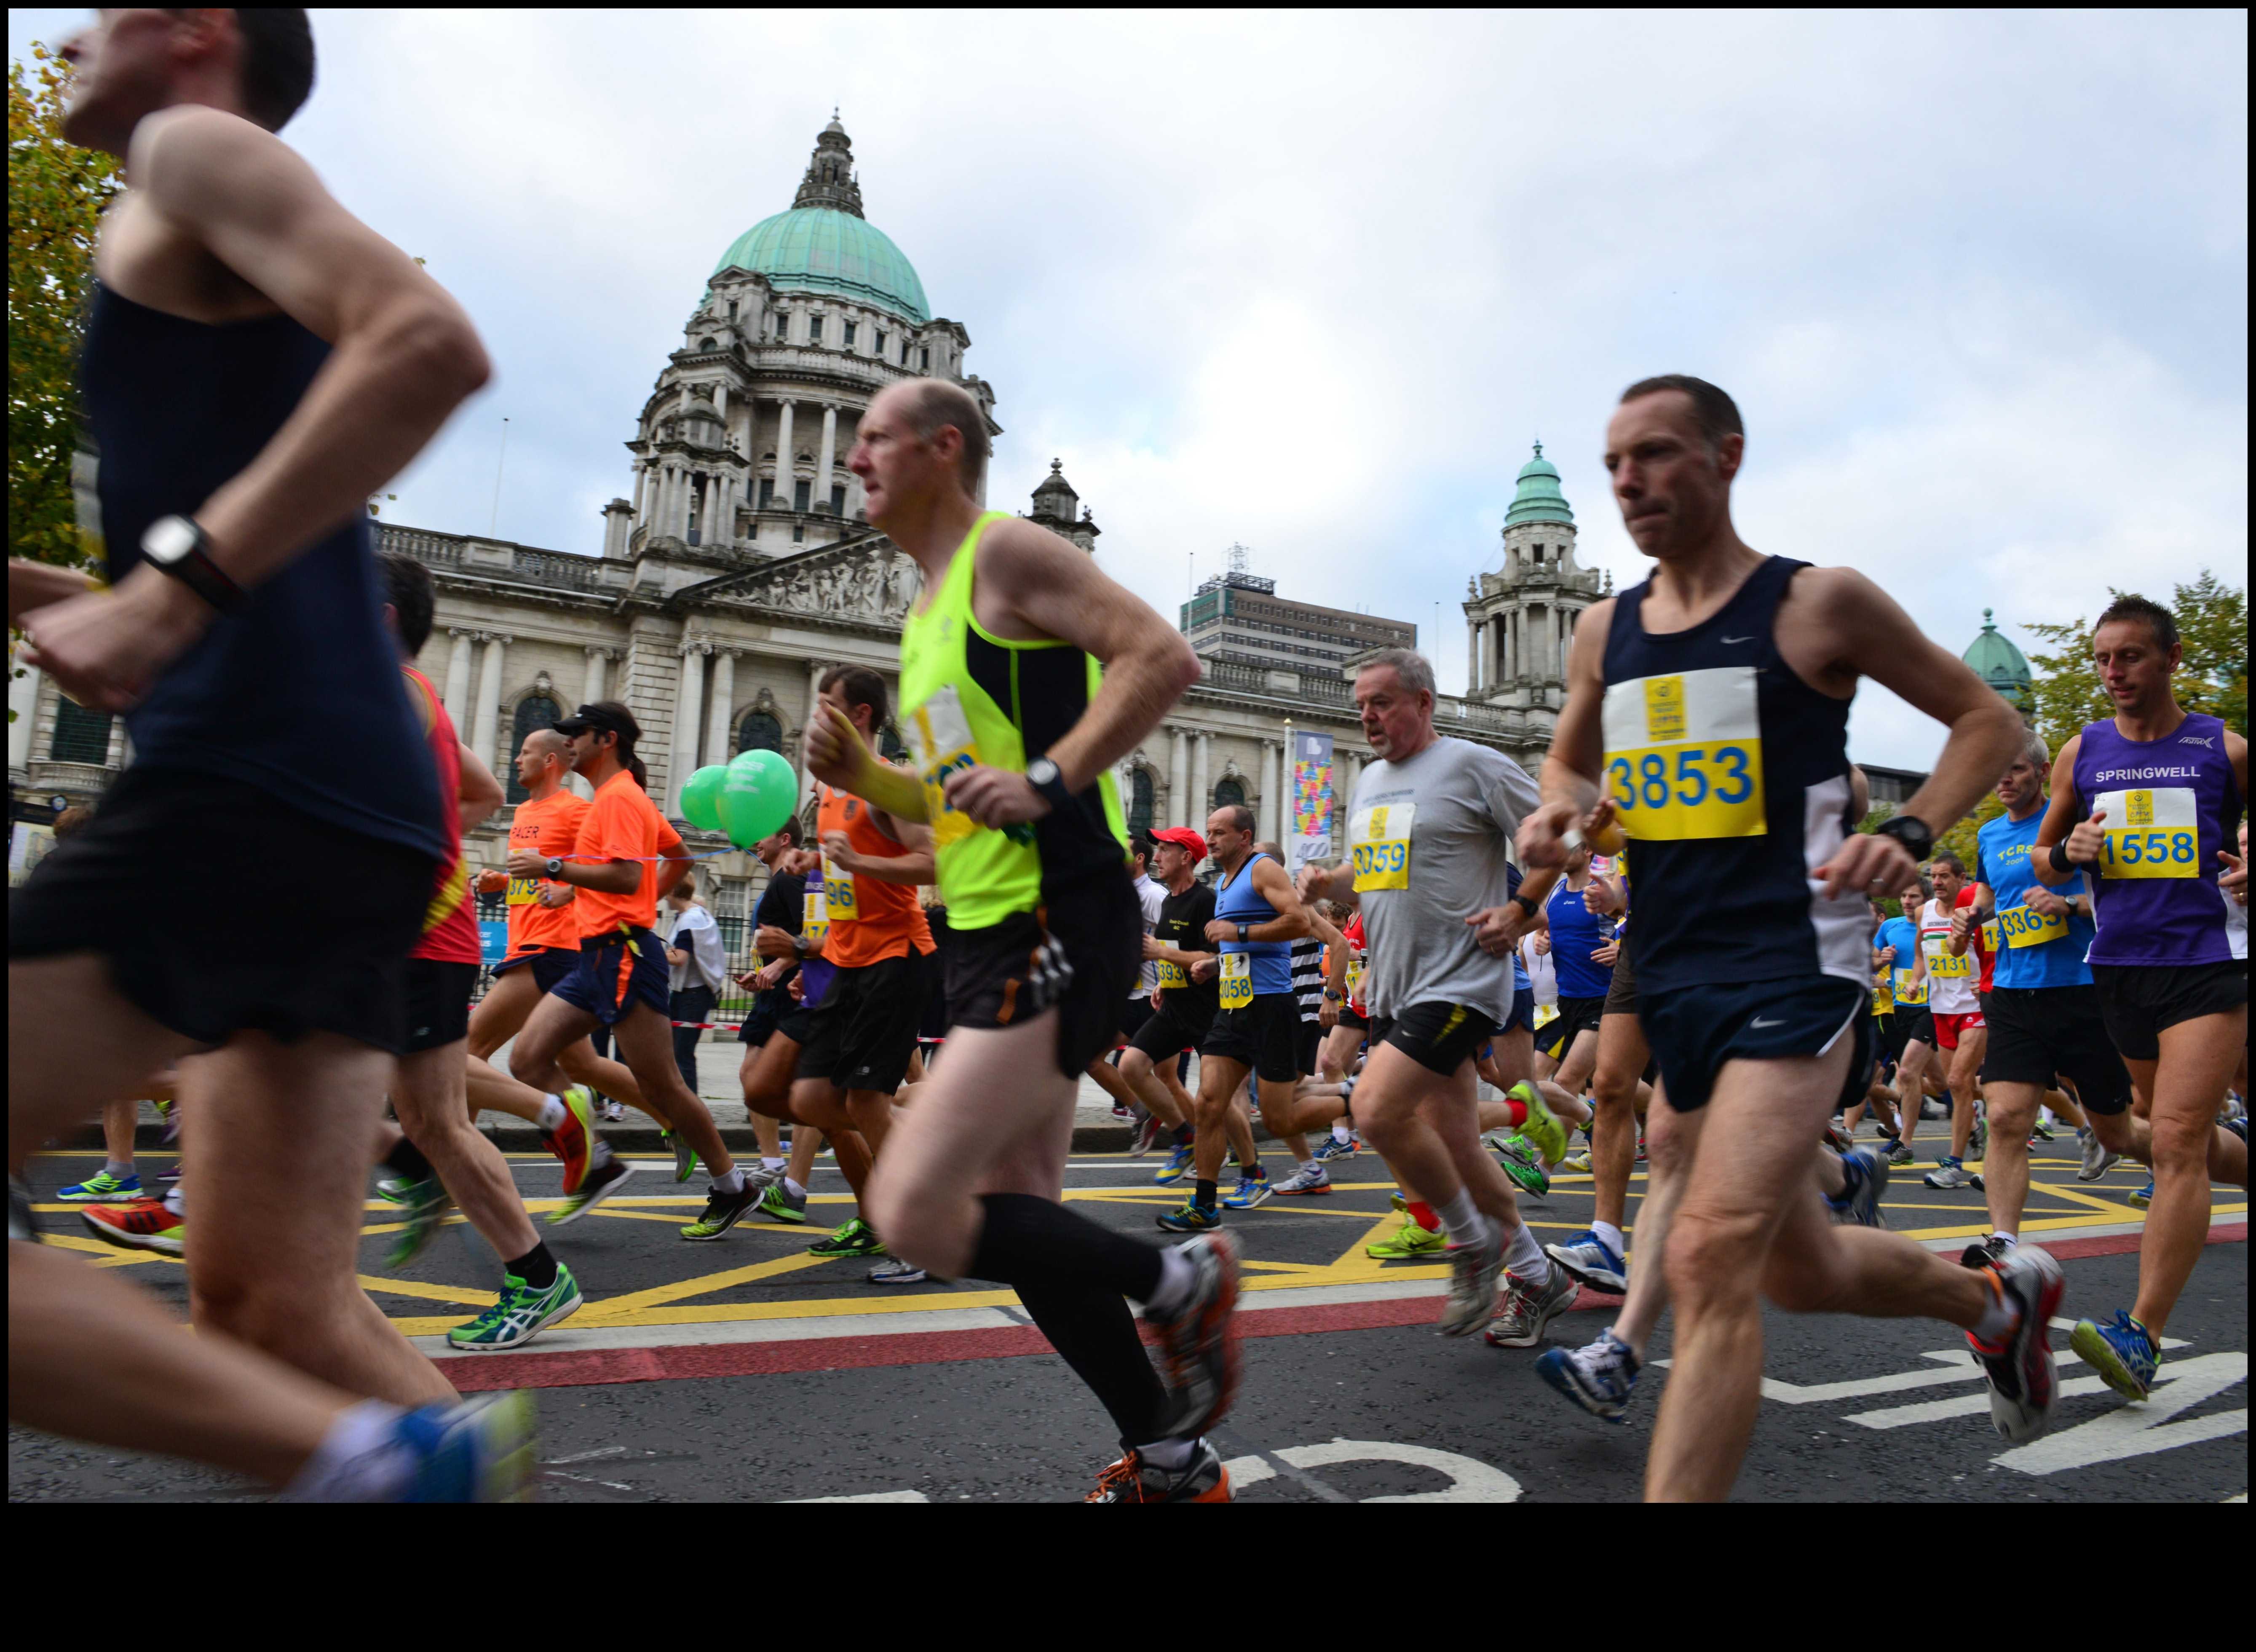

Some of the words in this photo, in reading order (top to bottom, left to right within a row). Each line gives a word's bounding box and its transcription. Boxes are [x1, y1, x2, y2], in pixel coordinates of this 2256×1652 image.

[2178, 736, 2215, 749] FASTRAX
[1609, 746, 1753, 810] 3853
[2095, 766, 2201, 782] SPRINGWELL
[1997, 844, 2034, 861] TCRS
[2104, 833, 2194, 865] 1558
[1354, 842, 1405, 877] 3059
[2006, 857, 2024, 866] 2009
[1160, 964, 1183, 981] 393
[1930, 958, 1967, 971] 2131
[1220, 978, 1251, 998] 3058
[1896, 983, 1924, 998] 341
